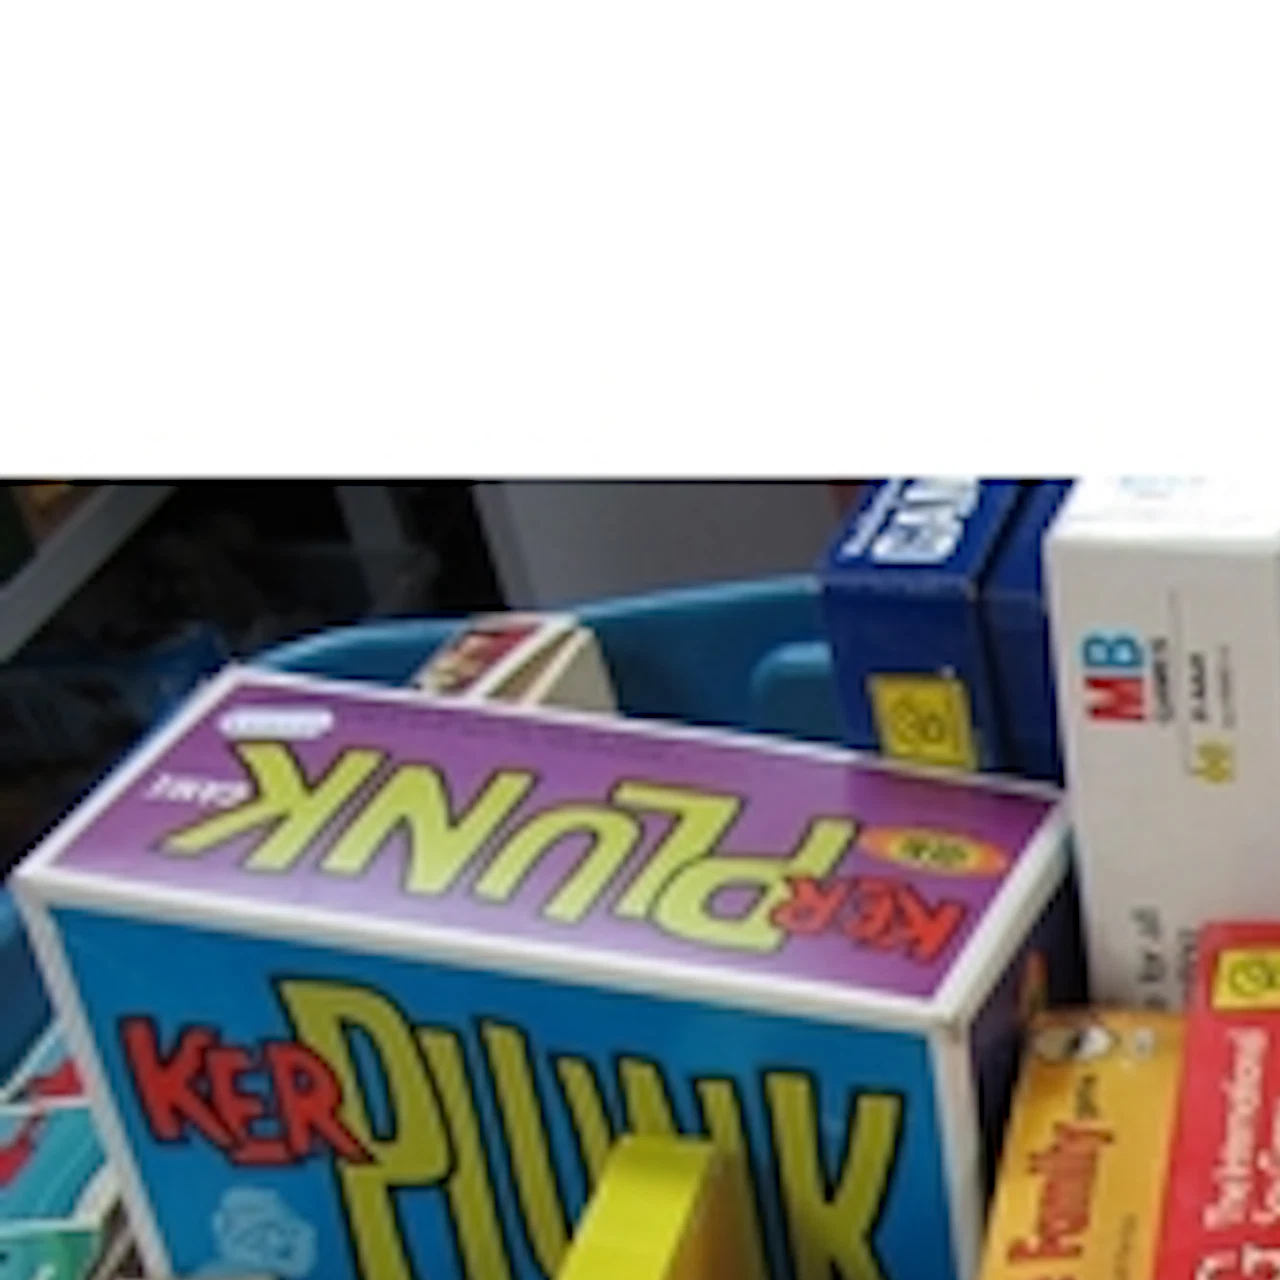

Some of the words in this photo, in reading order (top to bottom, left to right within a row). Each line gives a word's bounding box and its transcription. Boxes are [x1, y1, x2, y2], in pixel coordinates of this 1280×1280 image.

[1081, 629, 1151, 723] MB
[155, 740, 858, 955] PLUNK
[772, 873, 963, 961] KER
[117, 1016, 376, 1165] KER
[1008, 1122, 1116, 1262] Family
